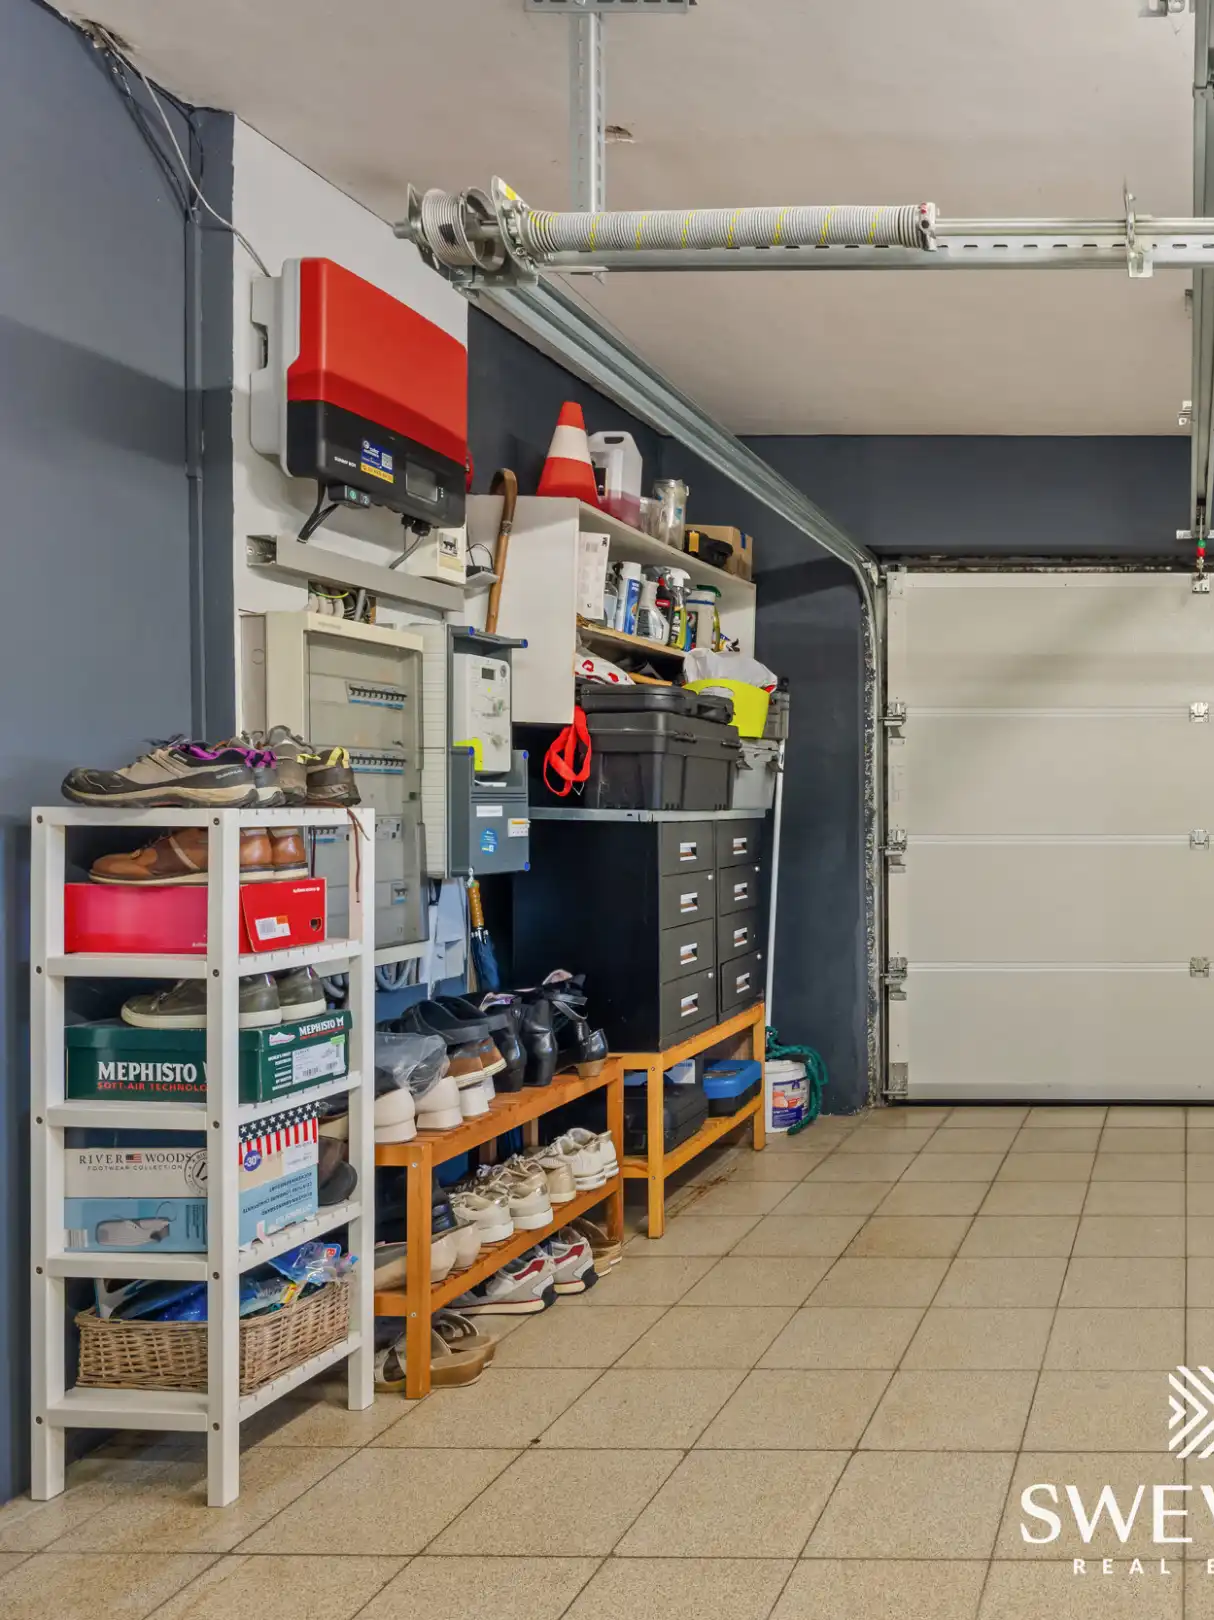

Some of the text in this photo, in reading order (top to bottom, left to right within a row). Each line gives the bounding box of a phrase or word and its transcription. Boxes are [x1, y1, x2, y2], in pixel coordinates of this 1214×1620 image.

[298, 1021, 336, 1037] MEPHISTO
[97, 1061, 198, 1083] MEPHISTO
[79, 1151, 191, 1165] RIVER WOODS
[132, 1163, 183, 1172] COLLECTION
